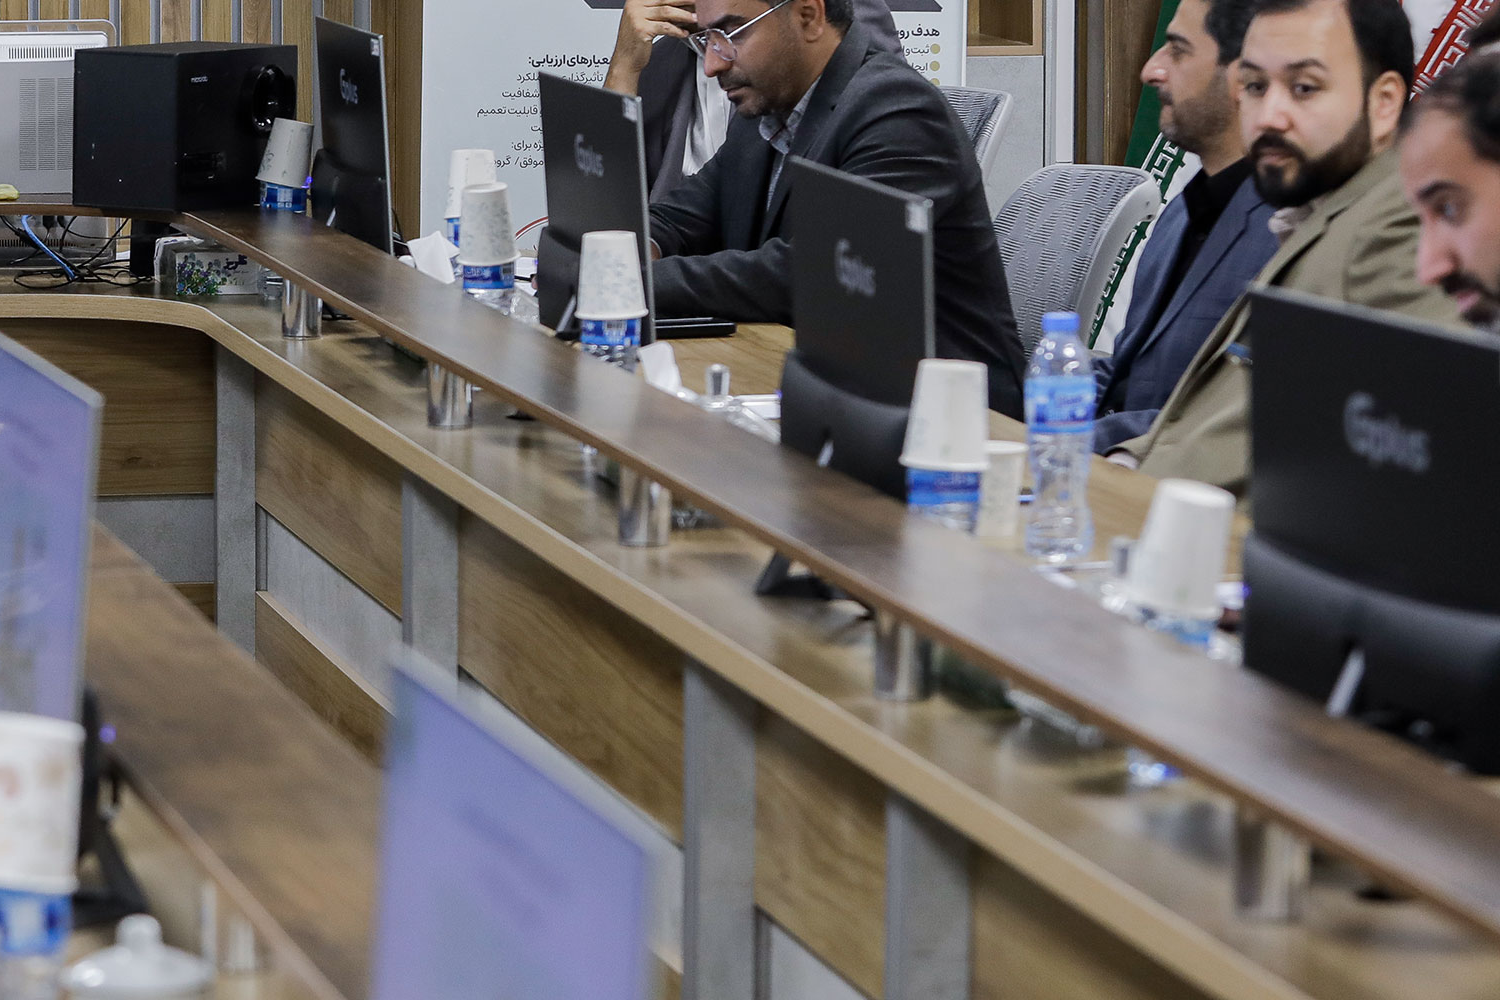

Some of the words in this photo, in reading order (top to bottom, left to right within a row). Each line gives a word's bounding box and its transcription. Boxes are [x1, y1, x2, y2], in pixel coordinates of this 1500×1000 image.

[911, 23, 940, 37] هدف
[528, 54, 566, 68] ارزیابی:
[502, 88, 540, 100] شفافیت
[476, 106, 507, 118] تعمیم
[508, 106, 538, 118] قابلیت
[512, 140, 532, 151] برای:
